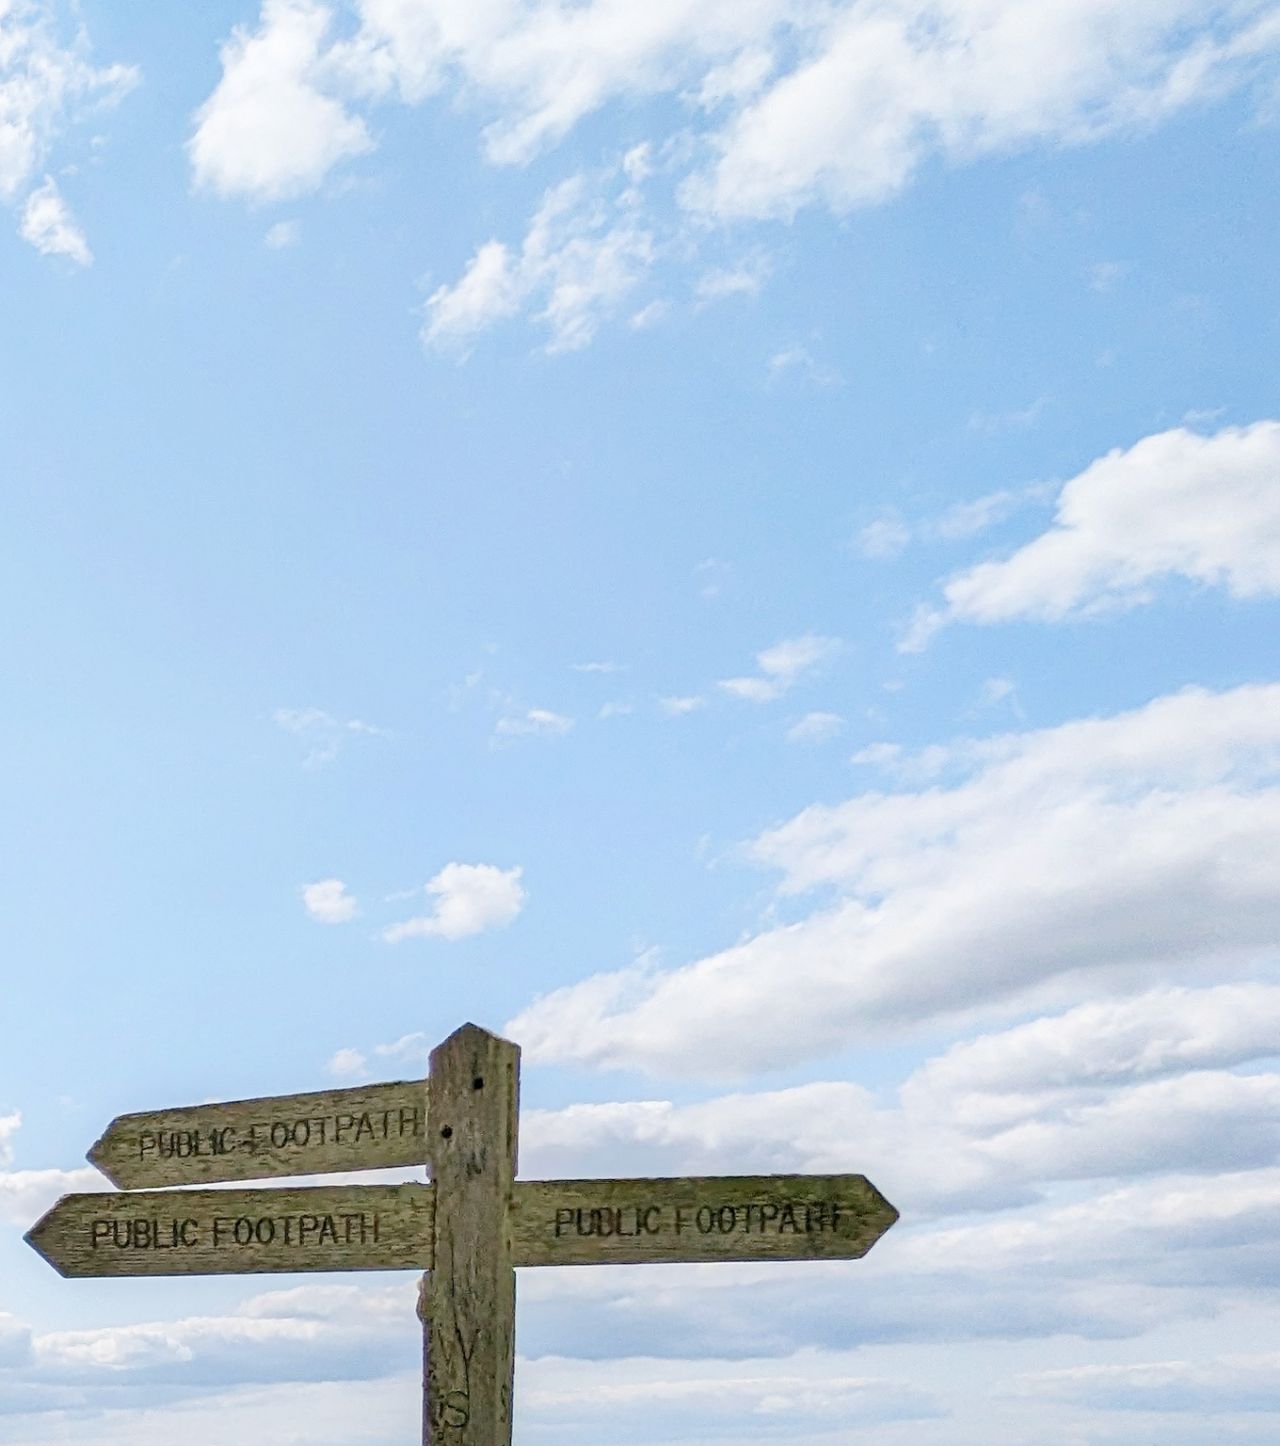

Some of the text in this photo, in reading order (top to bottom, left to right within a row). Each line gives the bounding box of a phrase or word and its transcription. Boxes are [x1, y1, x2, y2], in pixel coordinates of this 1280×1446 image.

[139, 1107, 419, 1161] PUBLIC FOOTPATH
[91, 1213, 380, 1249] PUBLIC FOOTPATH
[554, 1206, 661, 1238] PUBLIC
